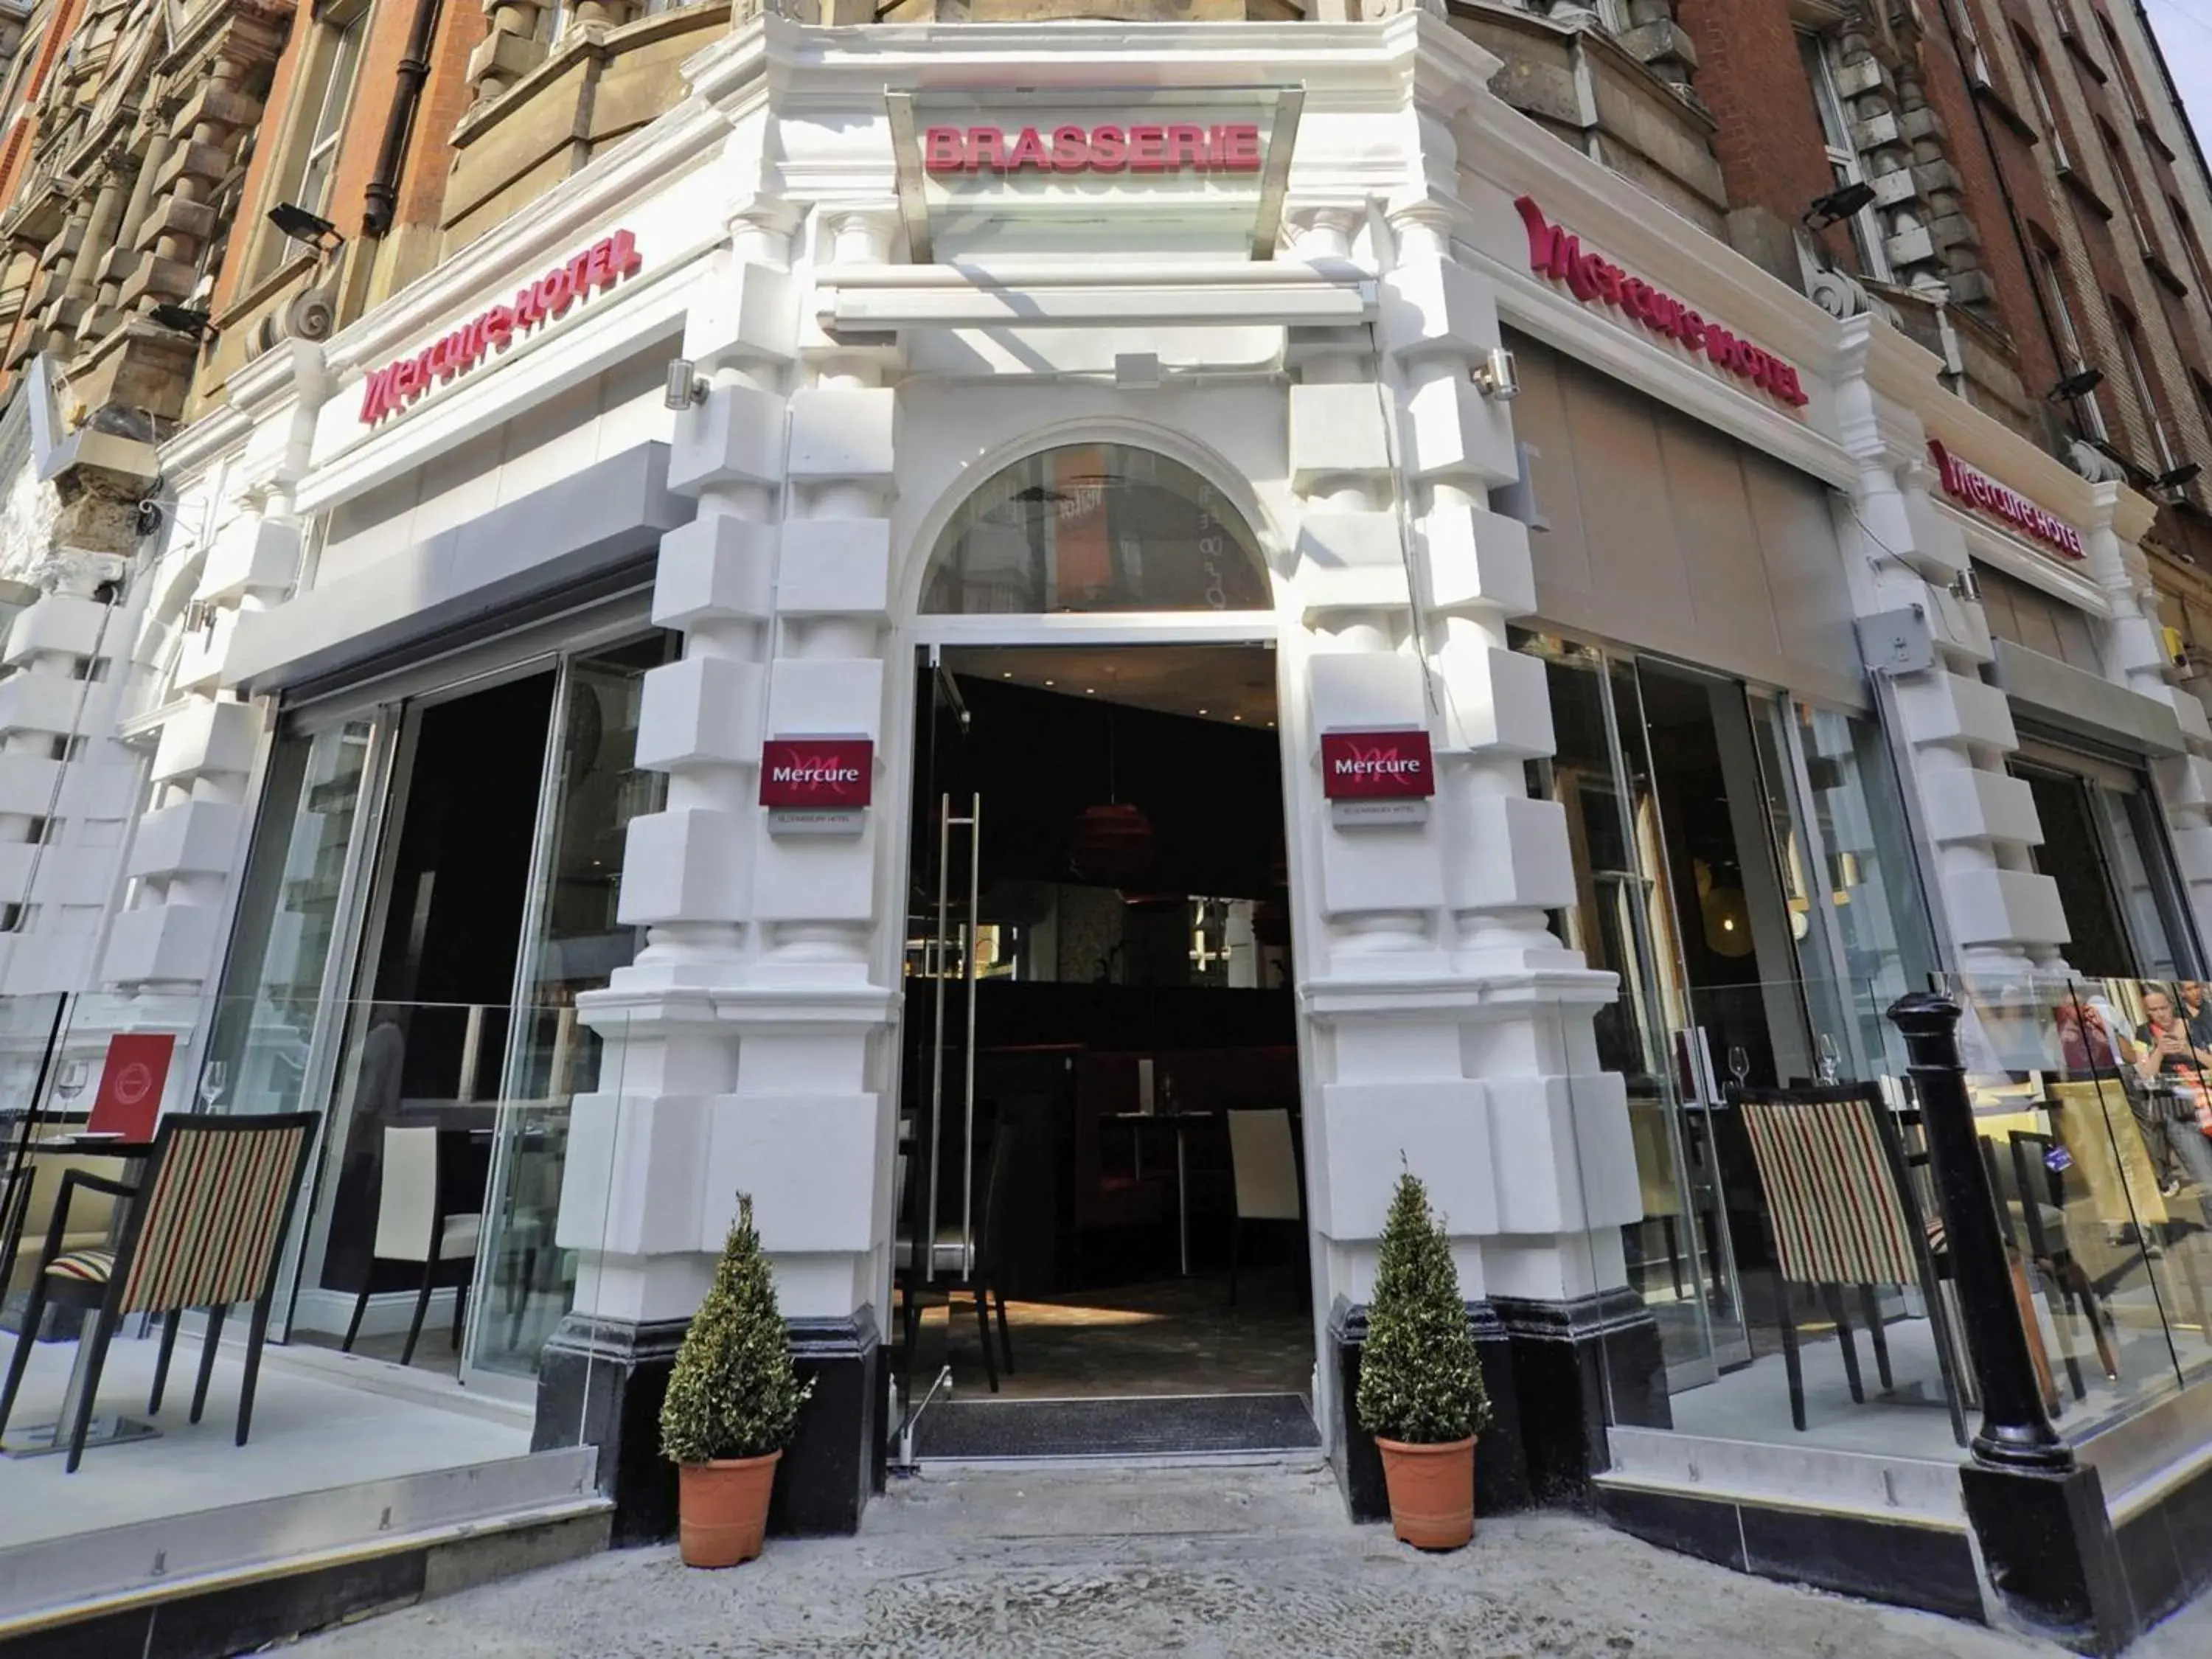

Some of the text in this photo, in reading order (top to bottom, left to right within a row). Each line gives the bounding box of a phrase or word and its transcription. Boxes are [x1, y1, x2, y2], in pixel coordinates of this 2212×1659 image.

[925, 123, 1262, 174] BRASSERIE
[773, 766, 859, 782] Mercure
[1335, 758, 1420, 774] Mercure
